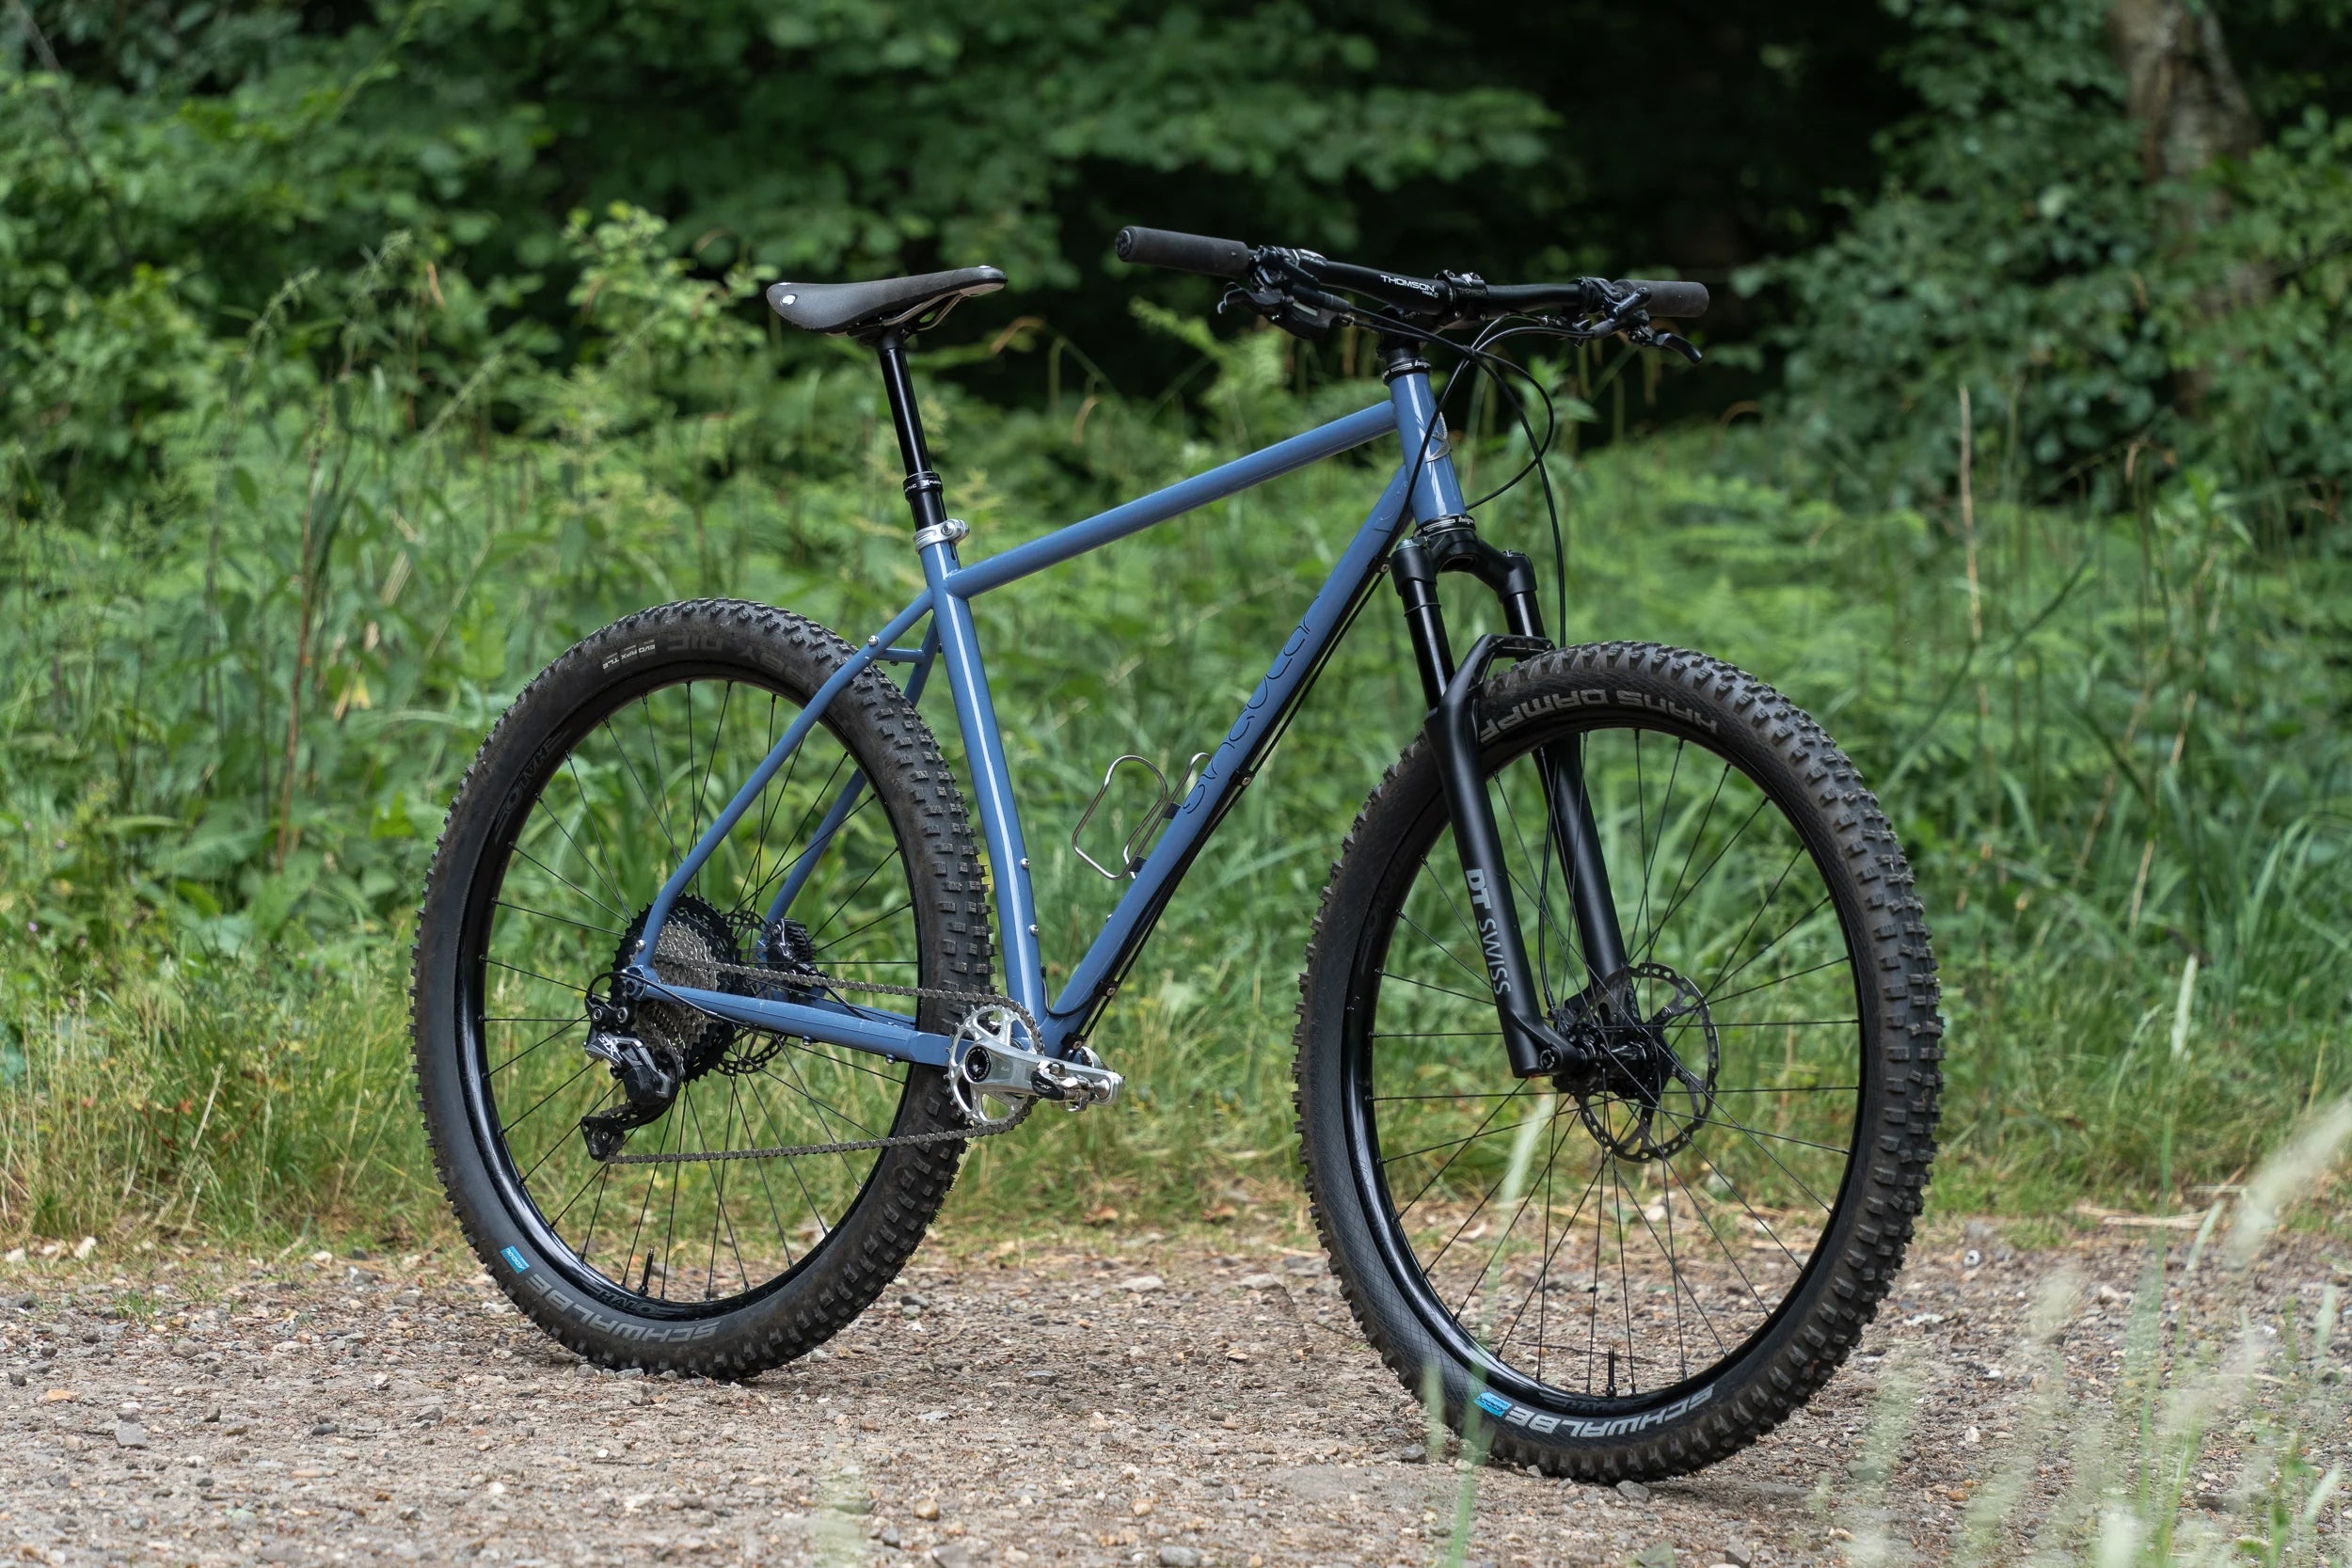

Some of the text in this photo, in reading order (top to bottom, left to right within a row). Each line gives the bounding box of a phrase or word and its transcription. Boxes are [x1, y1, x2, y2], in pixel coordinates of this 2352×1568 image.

[1380, 275, 1436, 292] THOMSON
[1480, 689, 1718, 744] HANS DAMPF
[1466, 868, 1511, 994] DT SWISS
[525, 1274, 720, 1342] SCHWALBE
[1505, 1383, 1716, 1437] SCHWALBE
